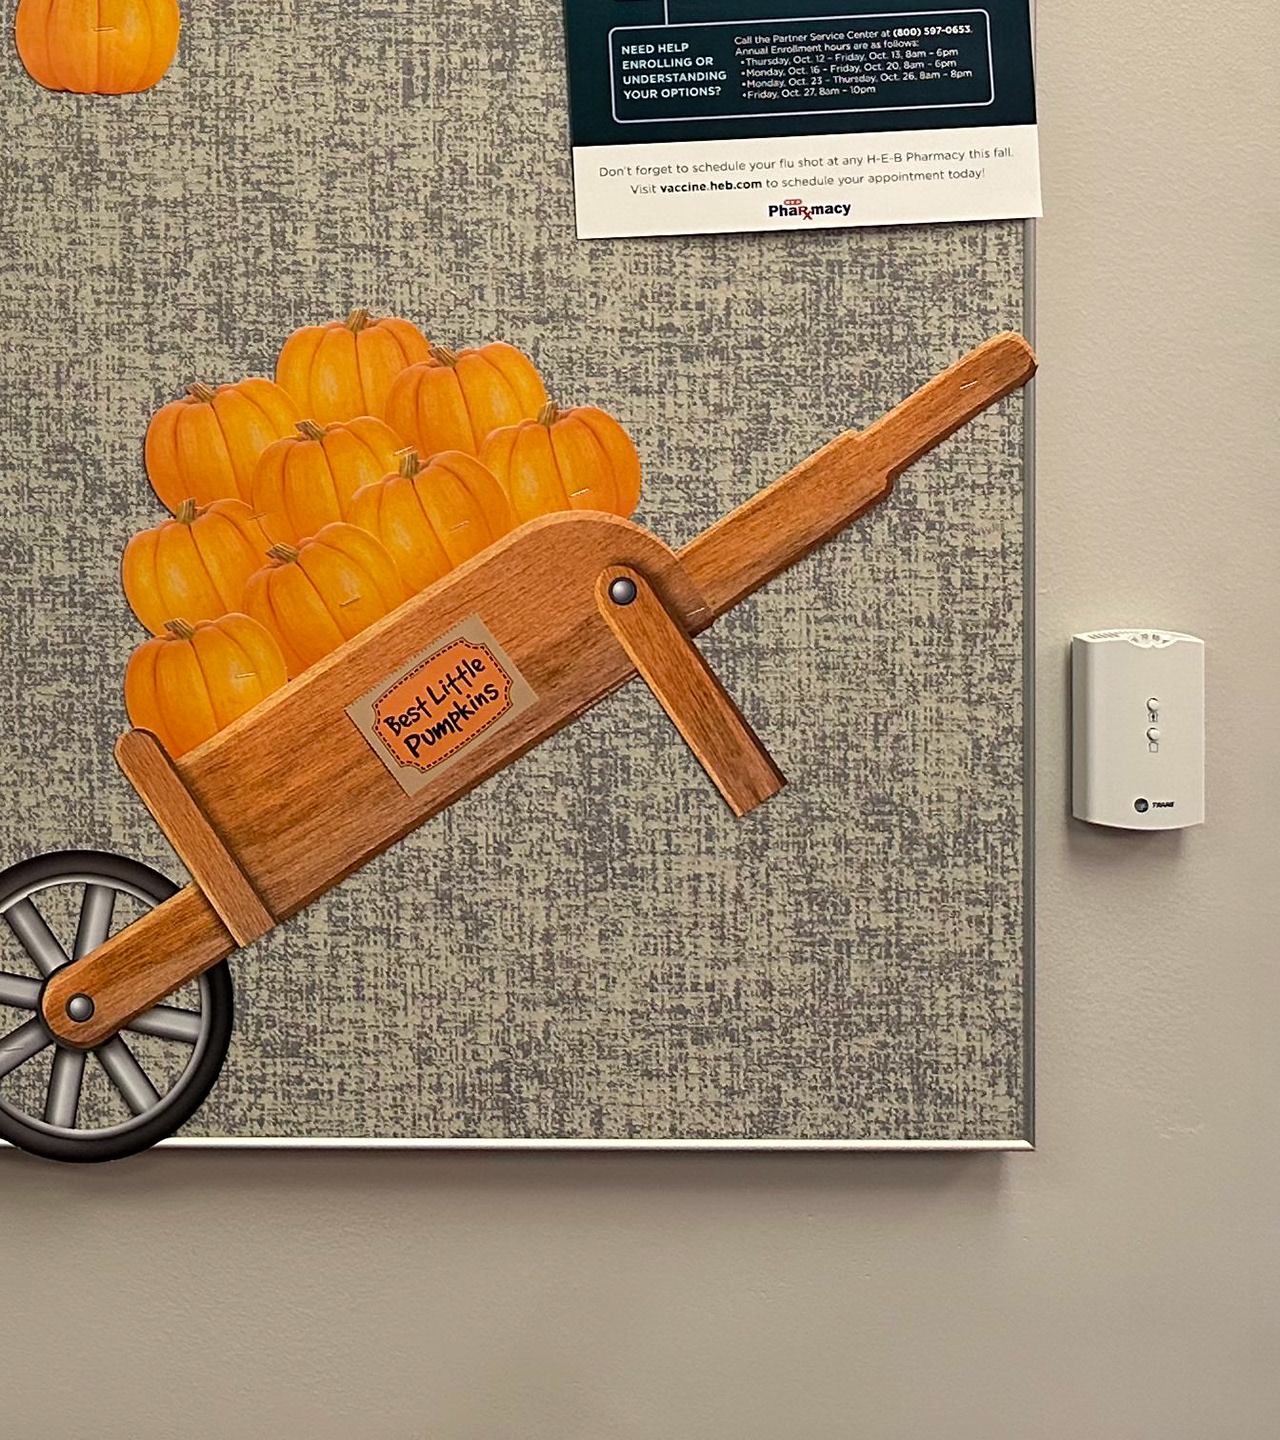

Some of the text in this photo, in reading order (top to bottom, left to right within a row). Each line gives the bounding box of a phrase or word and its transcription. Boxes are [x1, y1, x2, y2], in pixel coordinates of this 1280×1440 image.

[892, 27, 922, 38] (800)
[621, 42, 689, 55] NEED HELP
[622, 56, 714, 70] ENROLLING OR
[622, 70, 727, 85] UNDERSTANDING
[623, 86, 722, 100] YOUR OPTIONS?
[630, 167, 985, 195] Visit vaccine.heb.com to schedule your appointment today!
[383, 658, 486, 736] Best Little
[403, 683, 500, 758] Pumpkins
